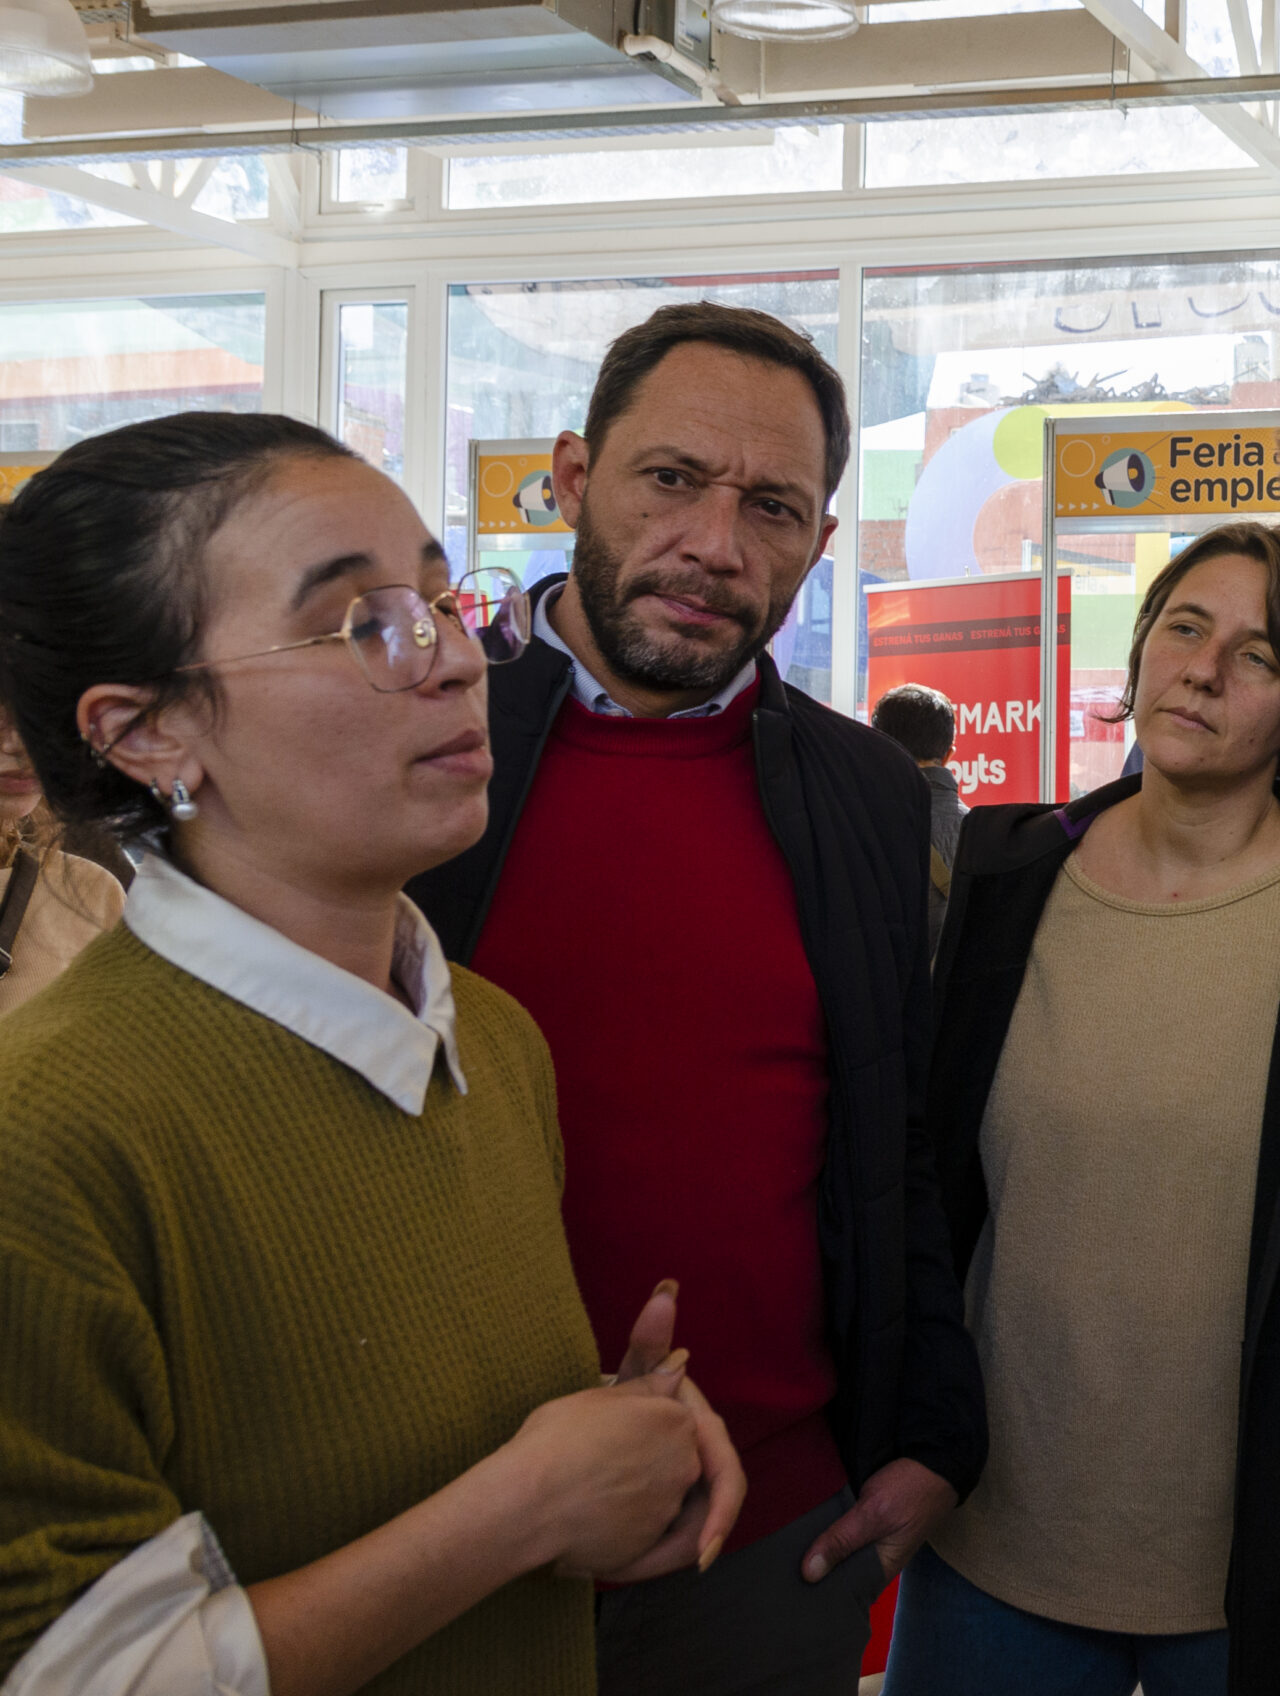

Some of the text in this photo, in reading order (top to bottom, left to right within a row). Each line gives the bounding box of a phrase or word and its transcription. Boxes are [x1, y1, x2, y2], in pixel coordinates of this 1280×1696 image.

[1170, 434, 1264, 468] Feria
[873, 634, 912, 647] ESTRENÁ
[914, 633, 931, 643] TUS
[933, 631, 963, 643] GANAS
[970, 627, 1012, 640] ESTRENÁ
[1013, 626, 1031, 637] TUS
[952, 700, 1041, 735] MARK
